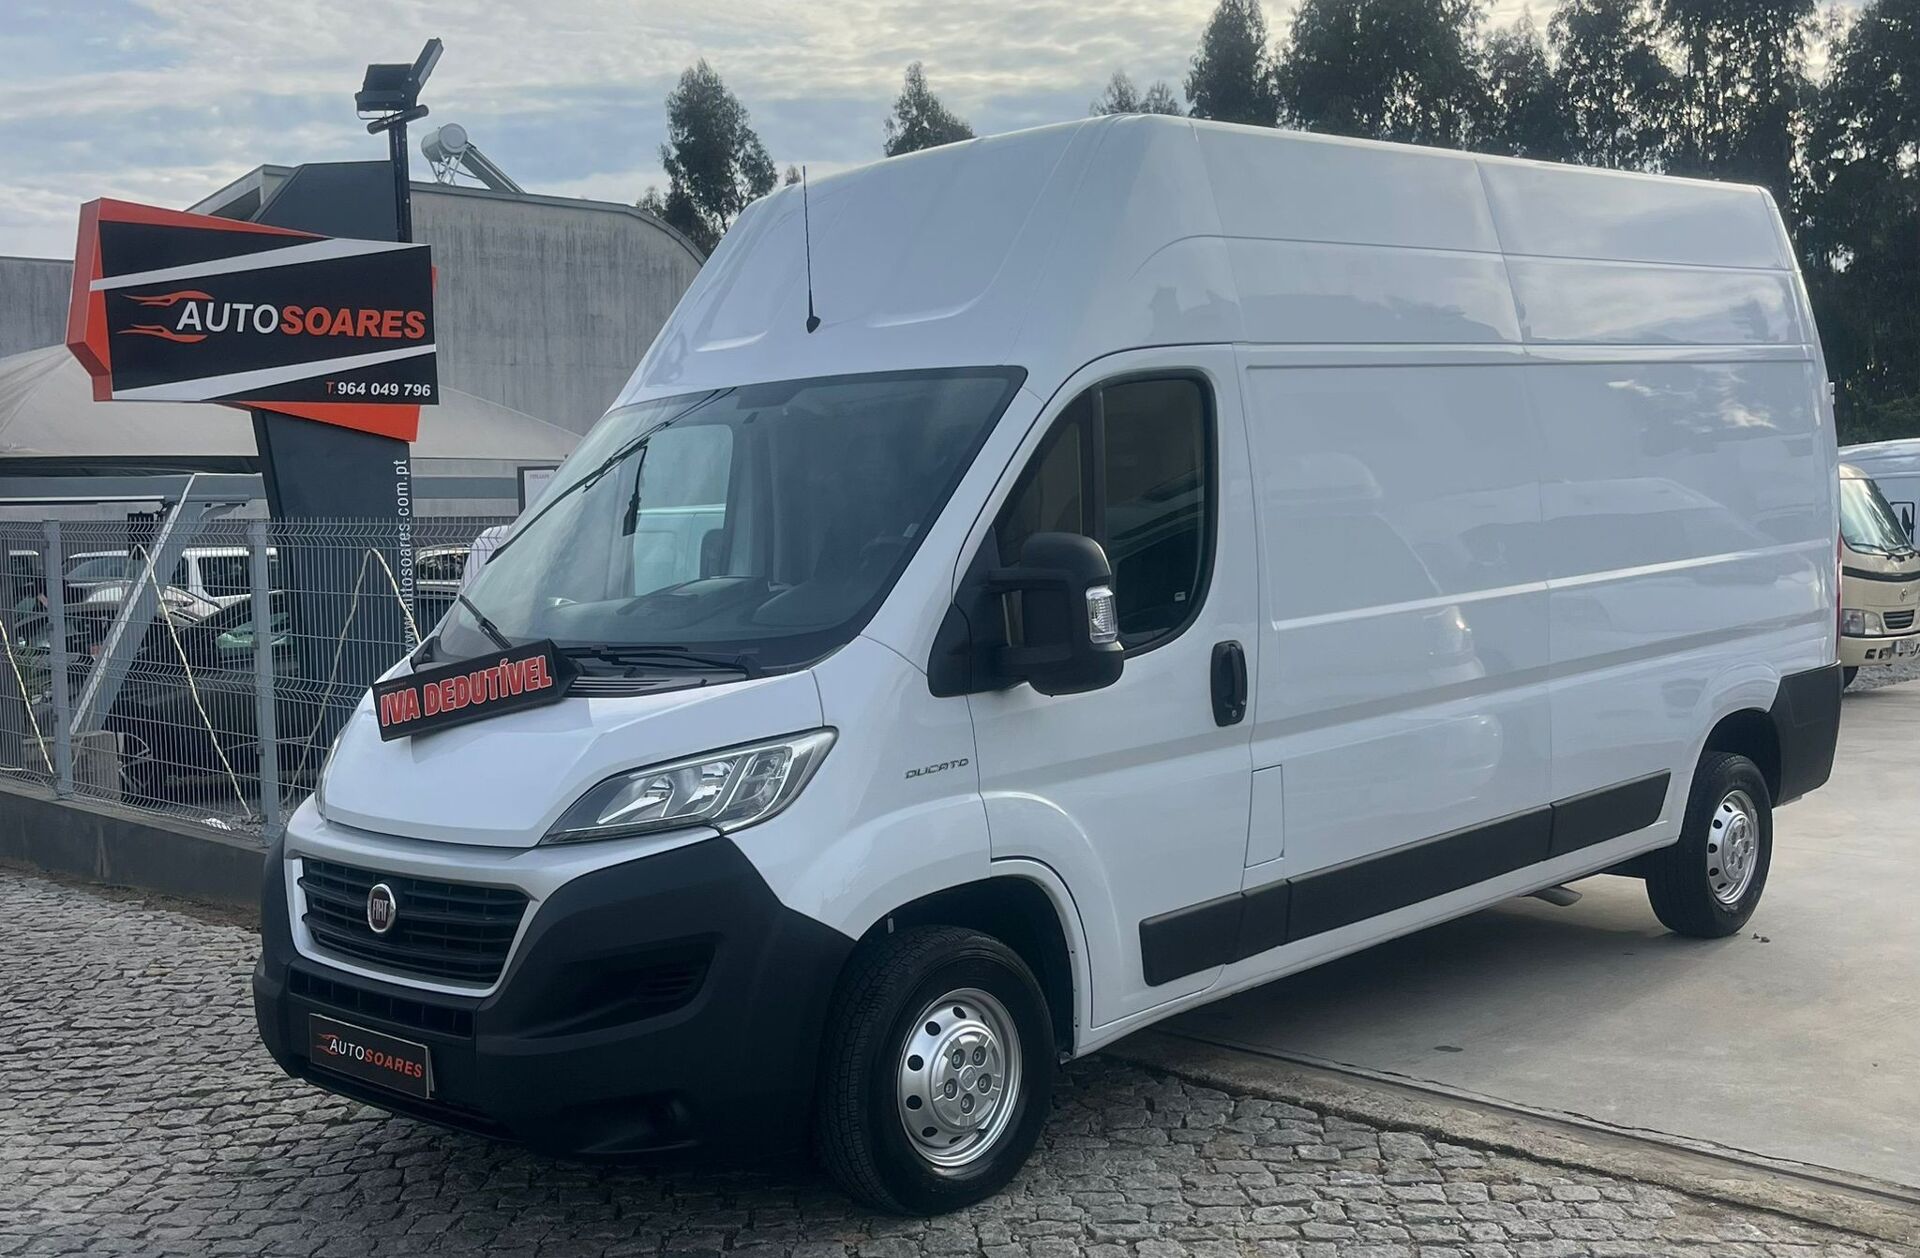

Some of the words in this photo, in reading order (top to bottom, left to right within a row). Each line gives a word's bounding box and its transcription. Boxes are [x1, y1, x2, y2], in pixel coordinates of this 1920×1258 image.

[370, 382, 399, 396] 049
[403, 383, 431, 397] 796
[393, 459, 415, 655] wwwautosoares.com.pt
[380, 688, 421, 727] IVA
[423, 655, 552, 717] DEDUTÍVEL
[905, 758, 969, 779] DUCATO
[372, 898, 389, 922] FIAT
[329, 1038, 423, 1078] AUTOSOARES
